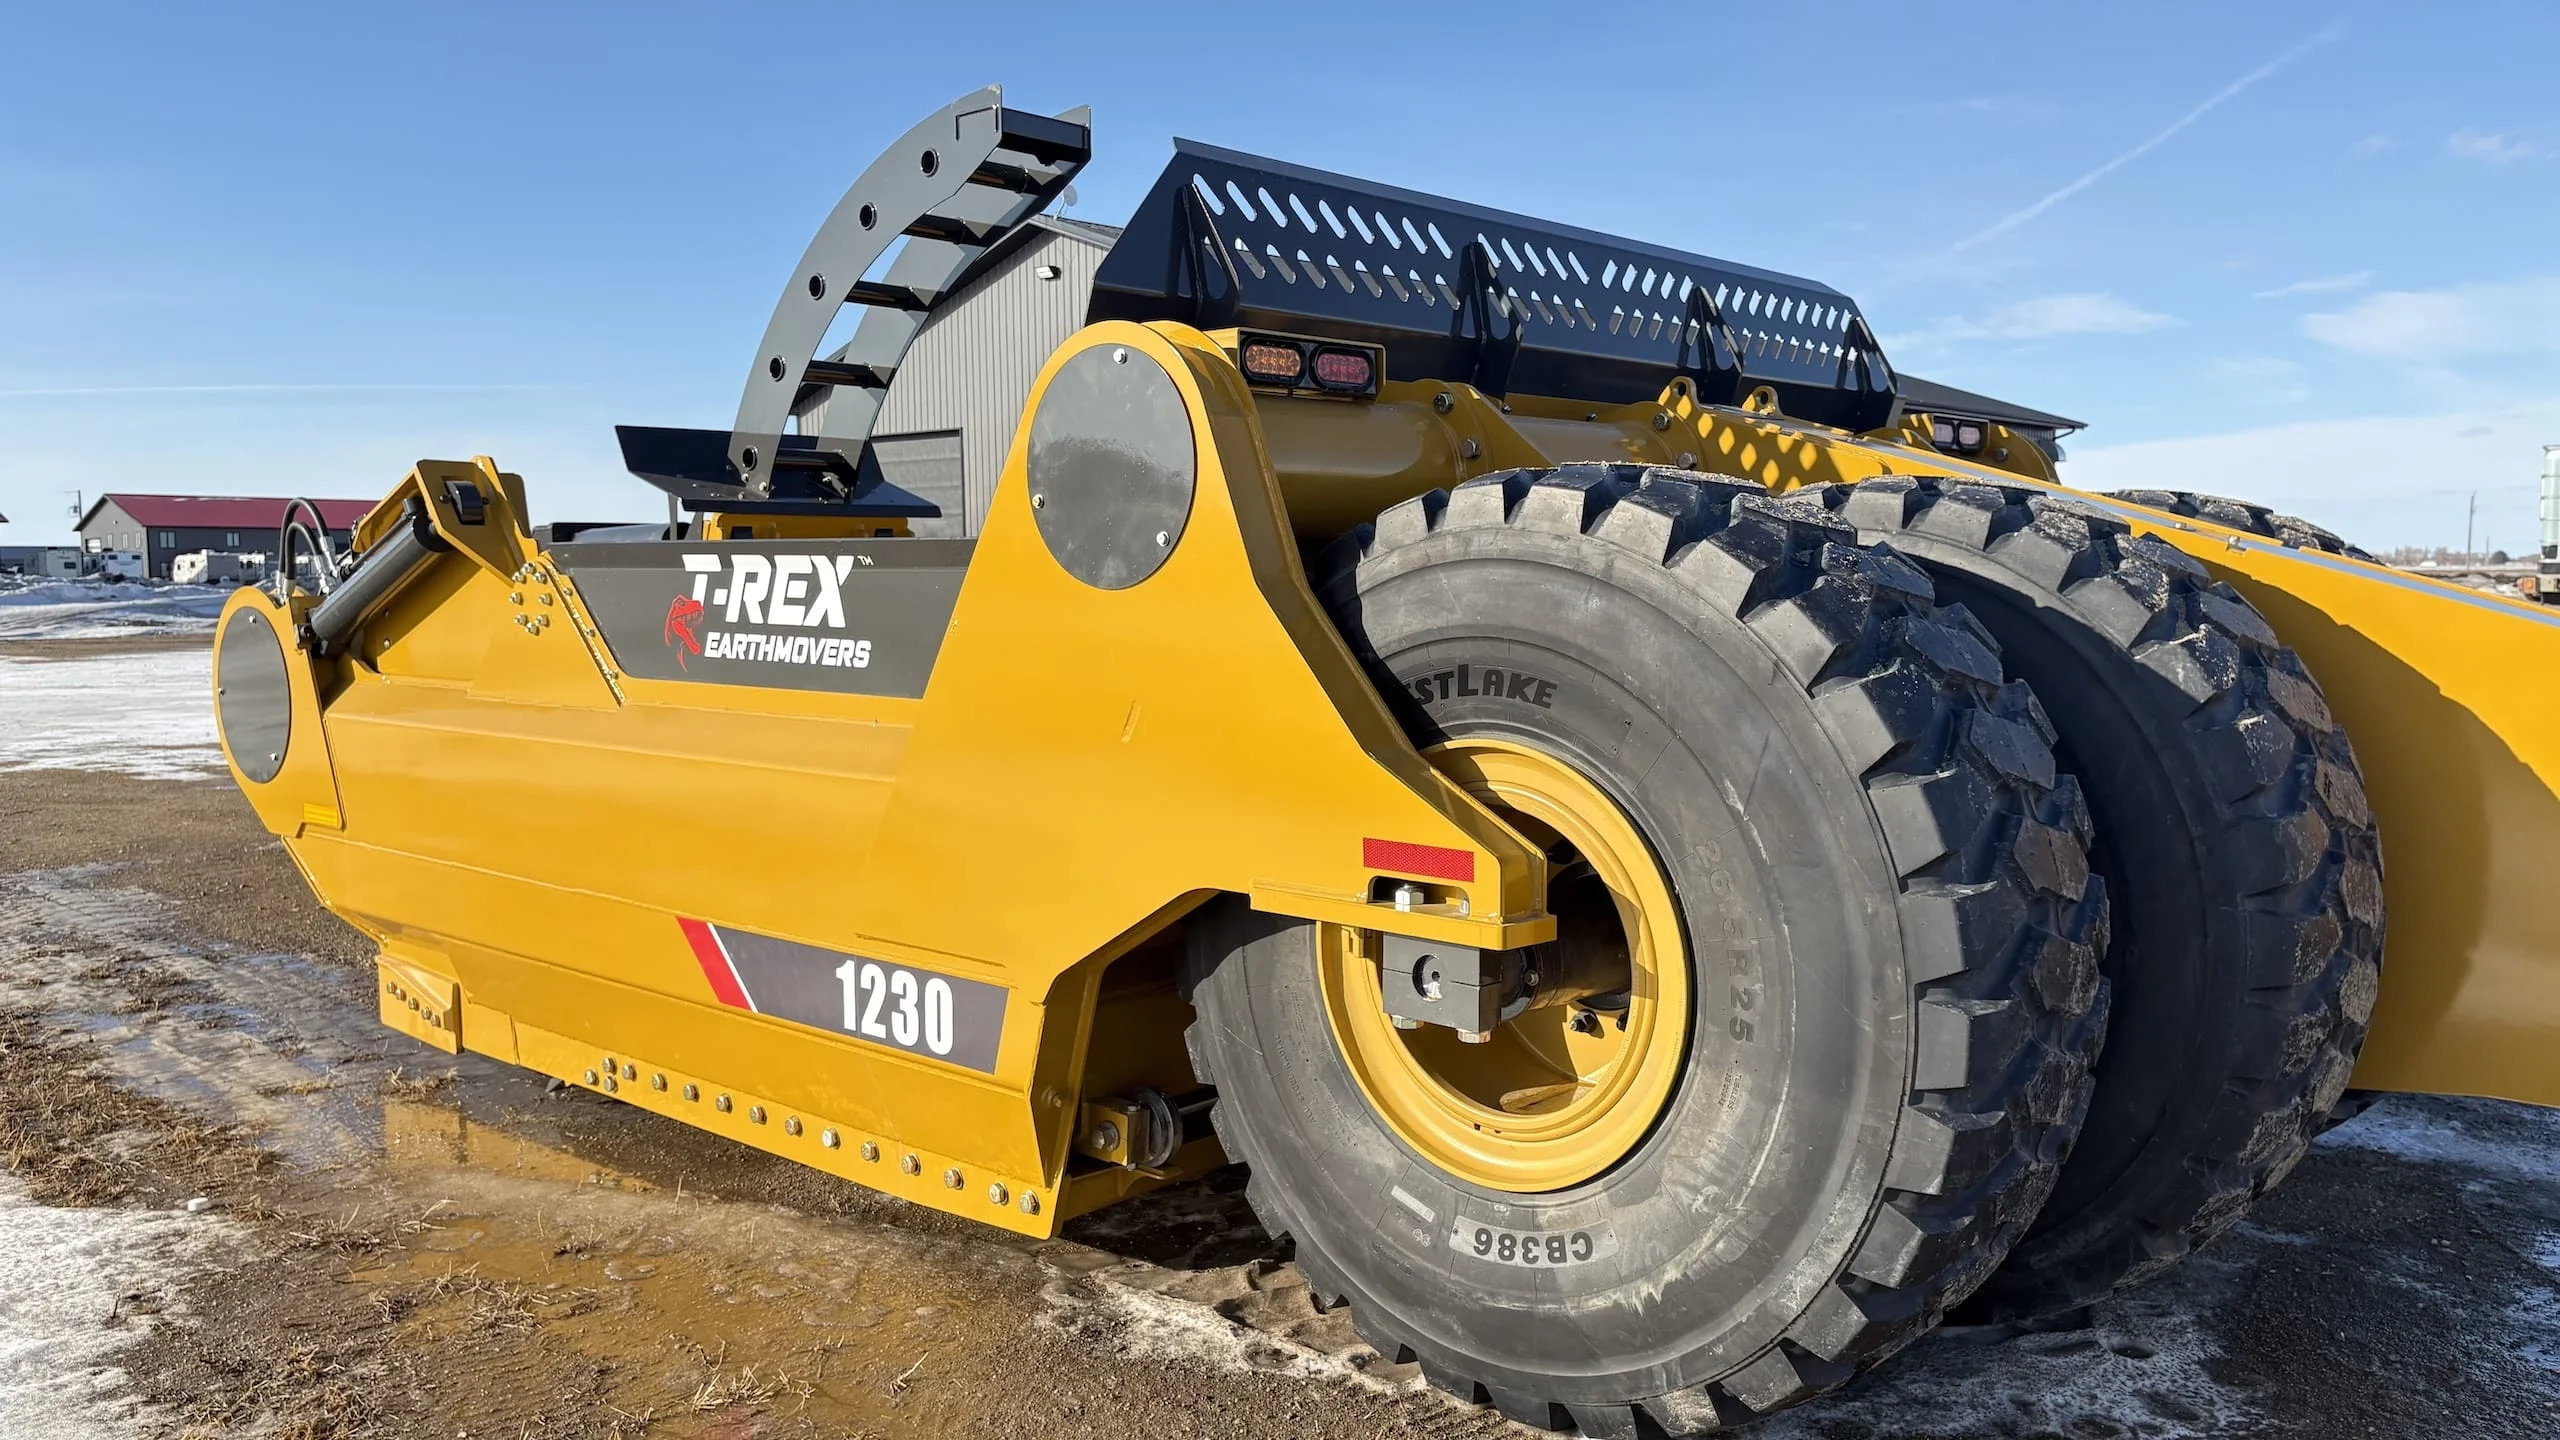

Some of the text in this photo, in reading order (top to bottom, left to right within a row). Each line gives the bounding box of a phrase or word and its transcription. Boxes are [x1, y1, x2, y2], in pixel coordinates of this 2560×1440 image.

[682, 554, 855, 628] T-REX
[704, 631, 872, 669] EARTHMOVERS
[835, 959, 954, 1056] 1230
[1473, 1227, 1594, 1265] CB386
